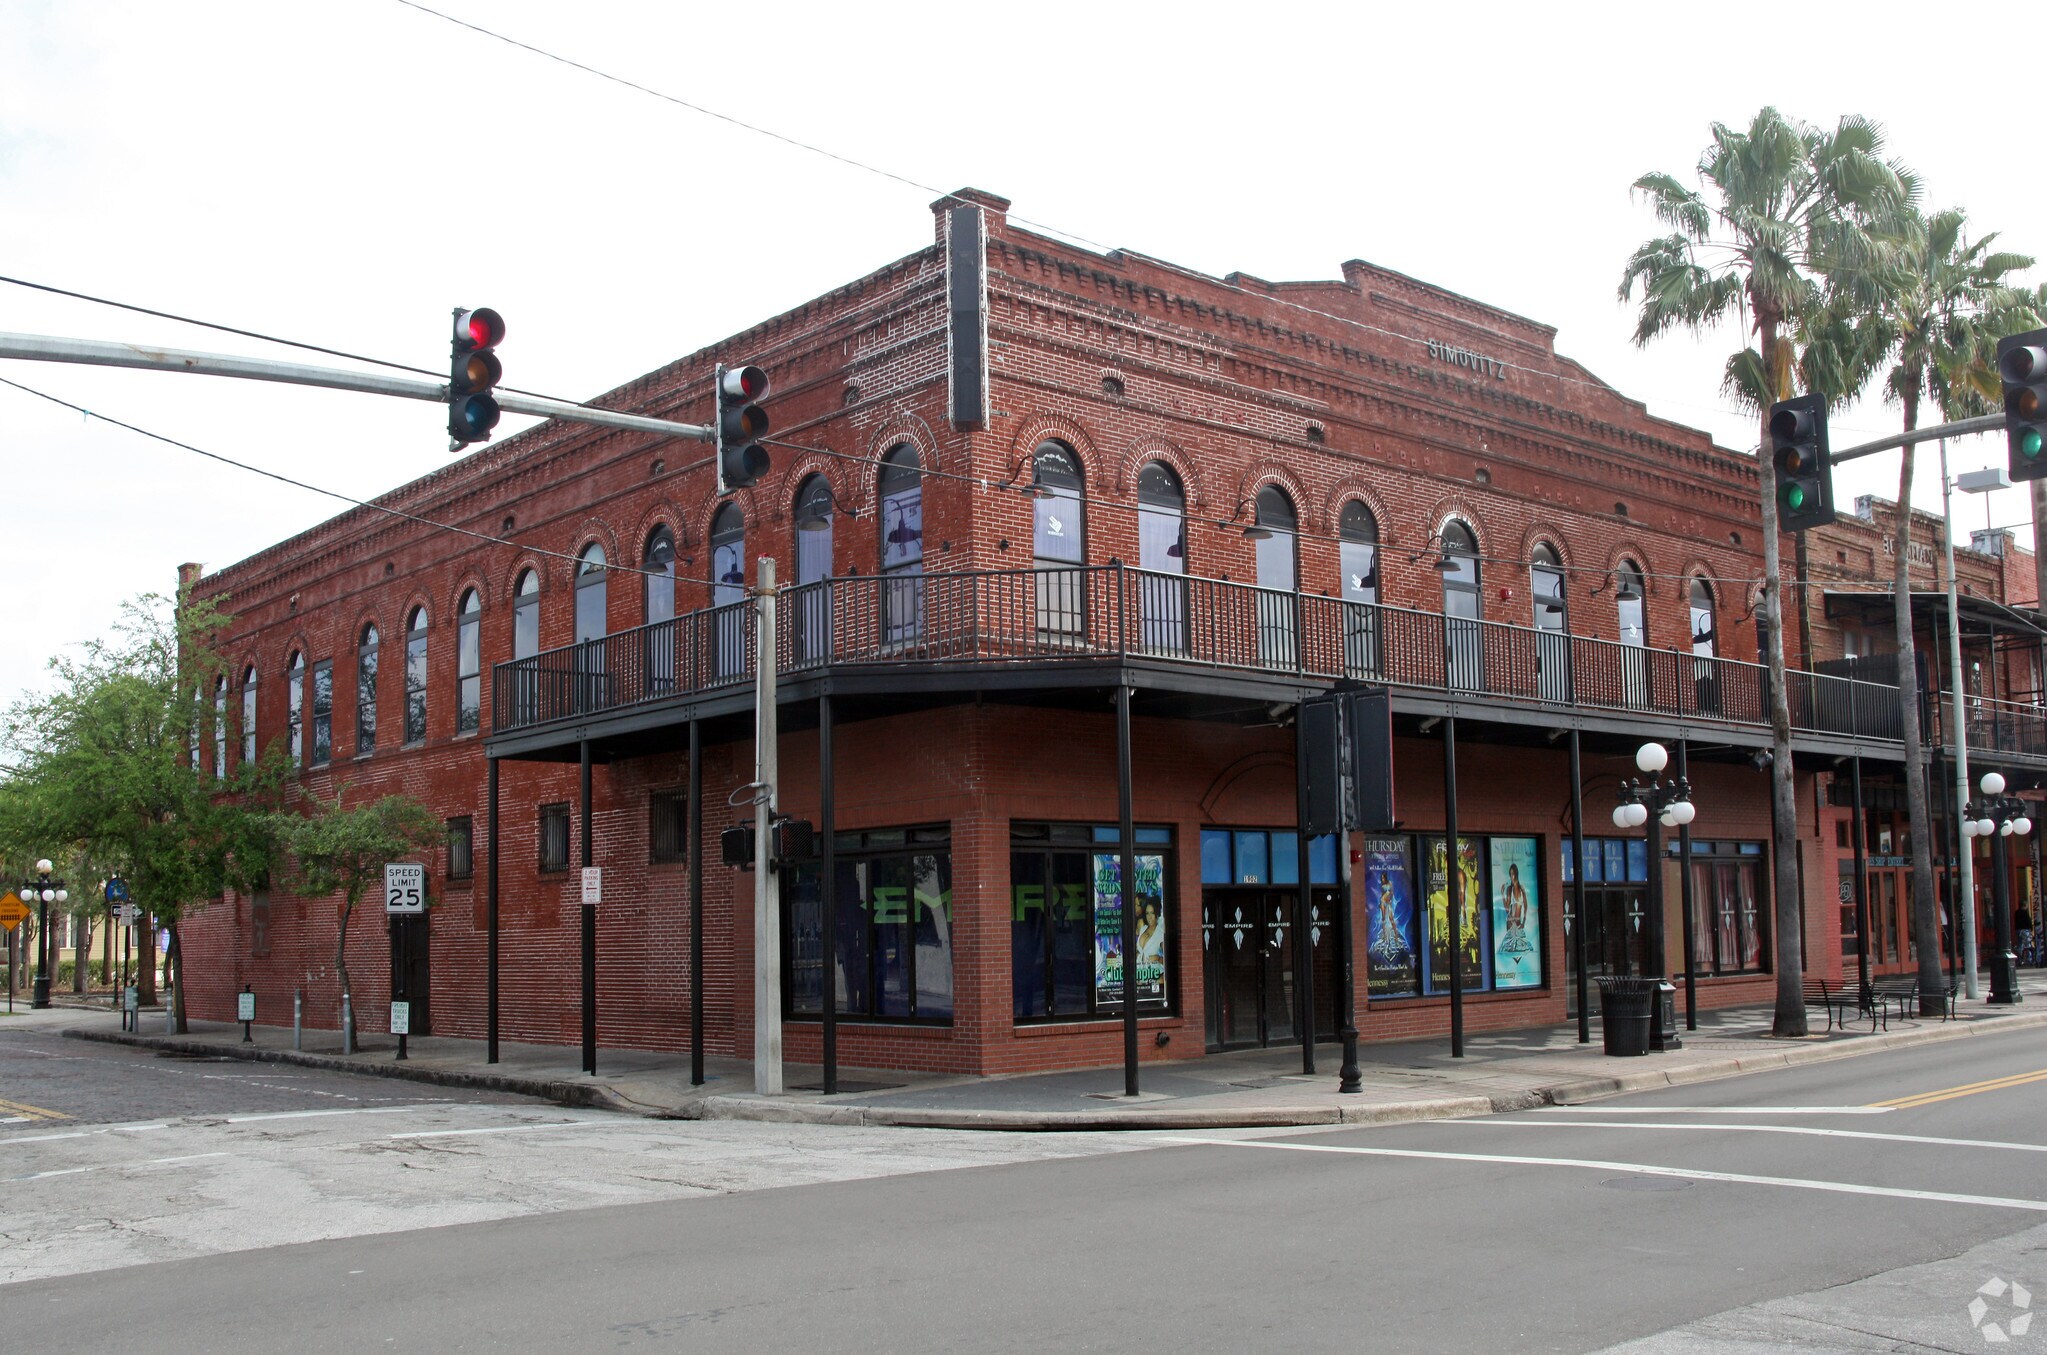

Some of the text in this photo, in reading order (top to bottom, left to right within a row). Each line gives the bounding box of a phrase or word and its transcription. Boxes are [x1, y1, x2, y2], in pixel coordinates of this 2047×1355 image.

[1364, 840, 1405, 852] THURSDAY
[389, 869, 420, 877] SPEED
[1432, 872, 1446, 881] FREE
[389, 889, 420, 906] 25
[1432, 972, 1451, 981] Hennes
